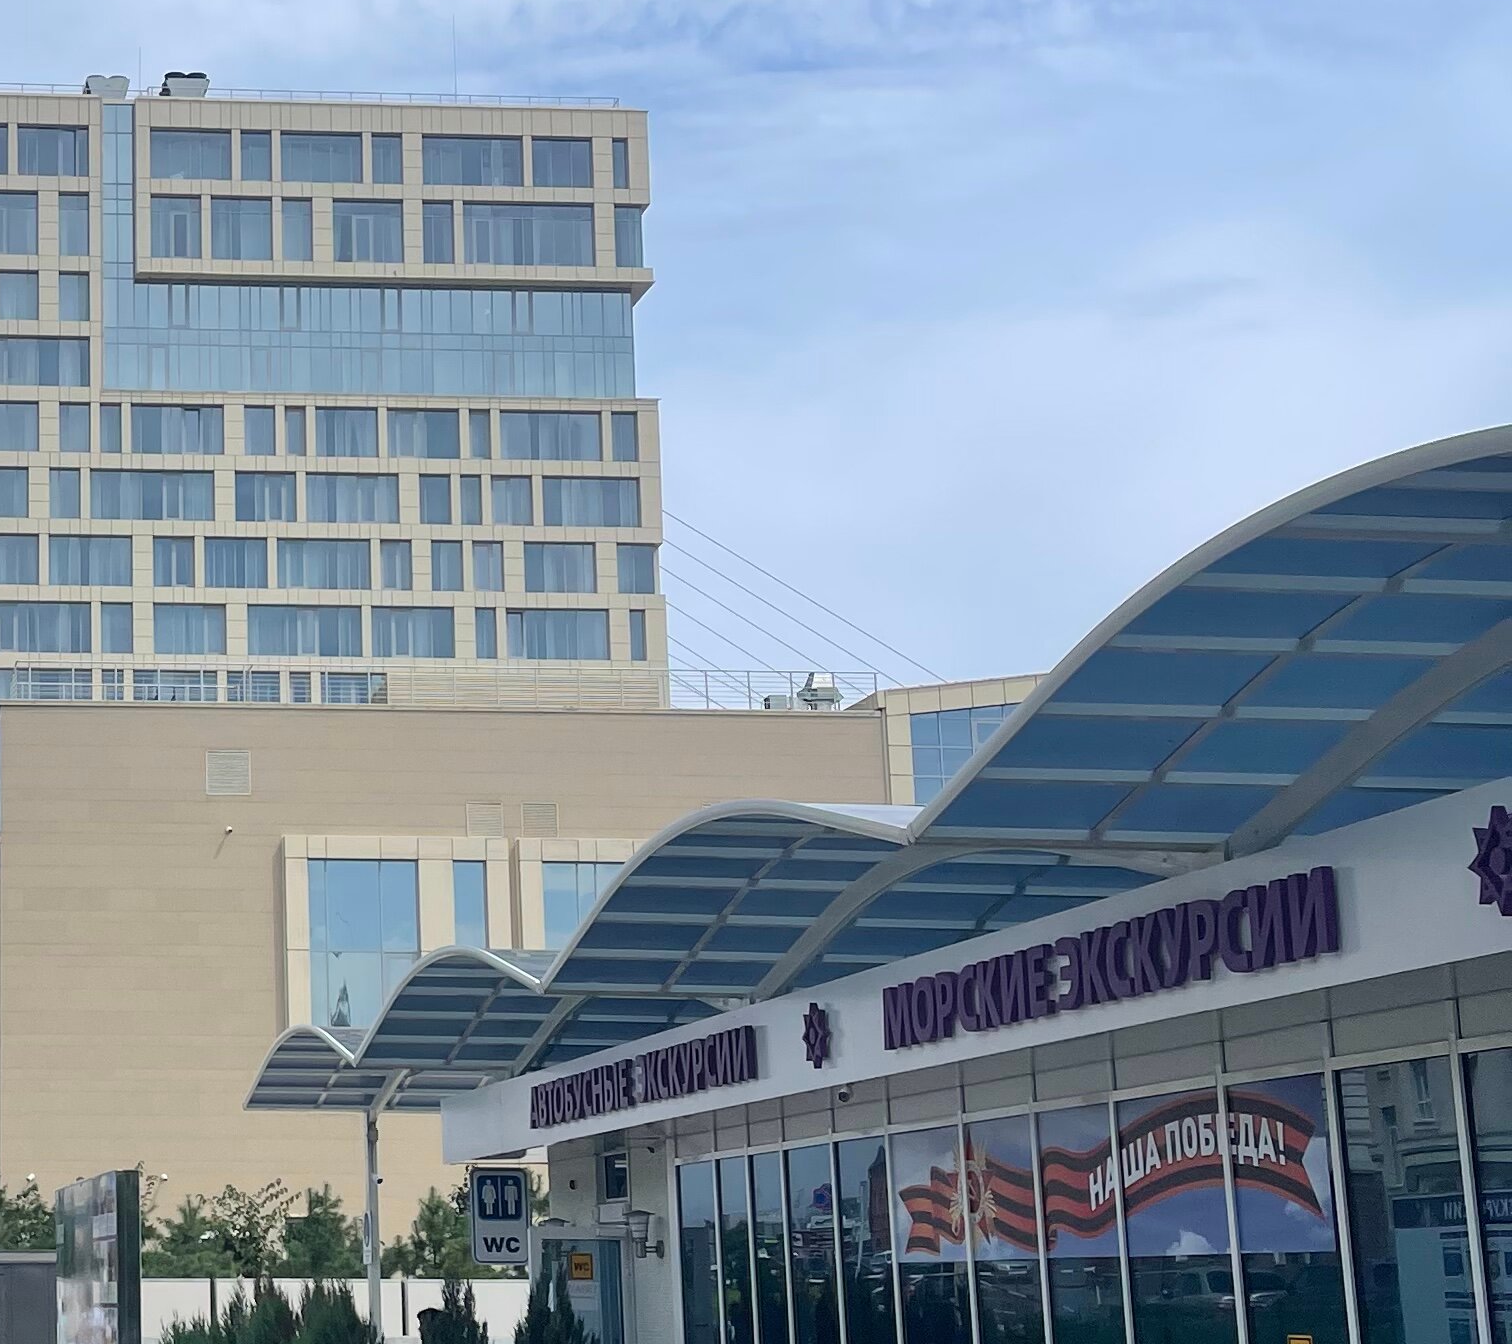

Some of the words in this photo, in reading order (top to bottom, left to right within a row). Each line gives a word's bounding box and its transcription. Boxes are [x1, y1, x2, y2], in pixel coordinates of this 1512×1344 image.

[884, 944, 1056, 1050] МОРСКИЕ
[1054, 865, 1339, 1010] ЭКСКУРСИИ
[530, 1058, 637, 1129] АВТОБУСНЫЕ
[635, 1025, 758, 1103] ЭКСКУРСИИ
[1089, 1131, 1162, 1212] НАША
[483, 1236, 521, 1253] WC
[574, 1262, 590, 1271] WC
